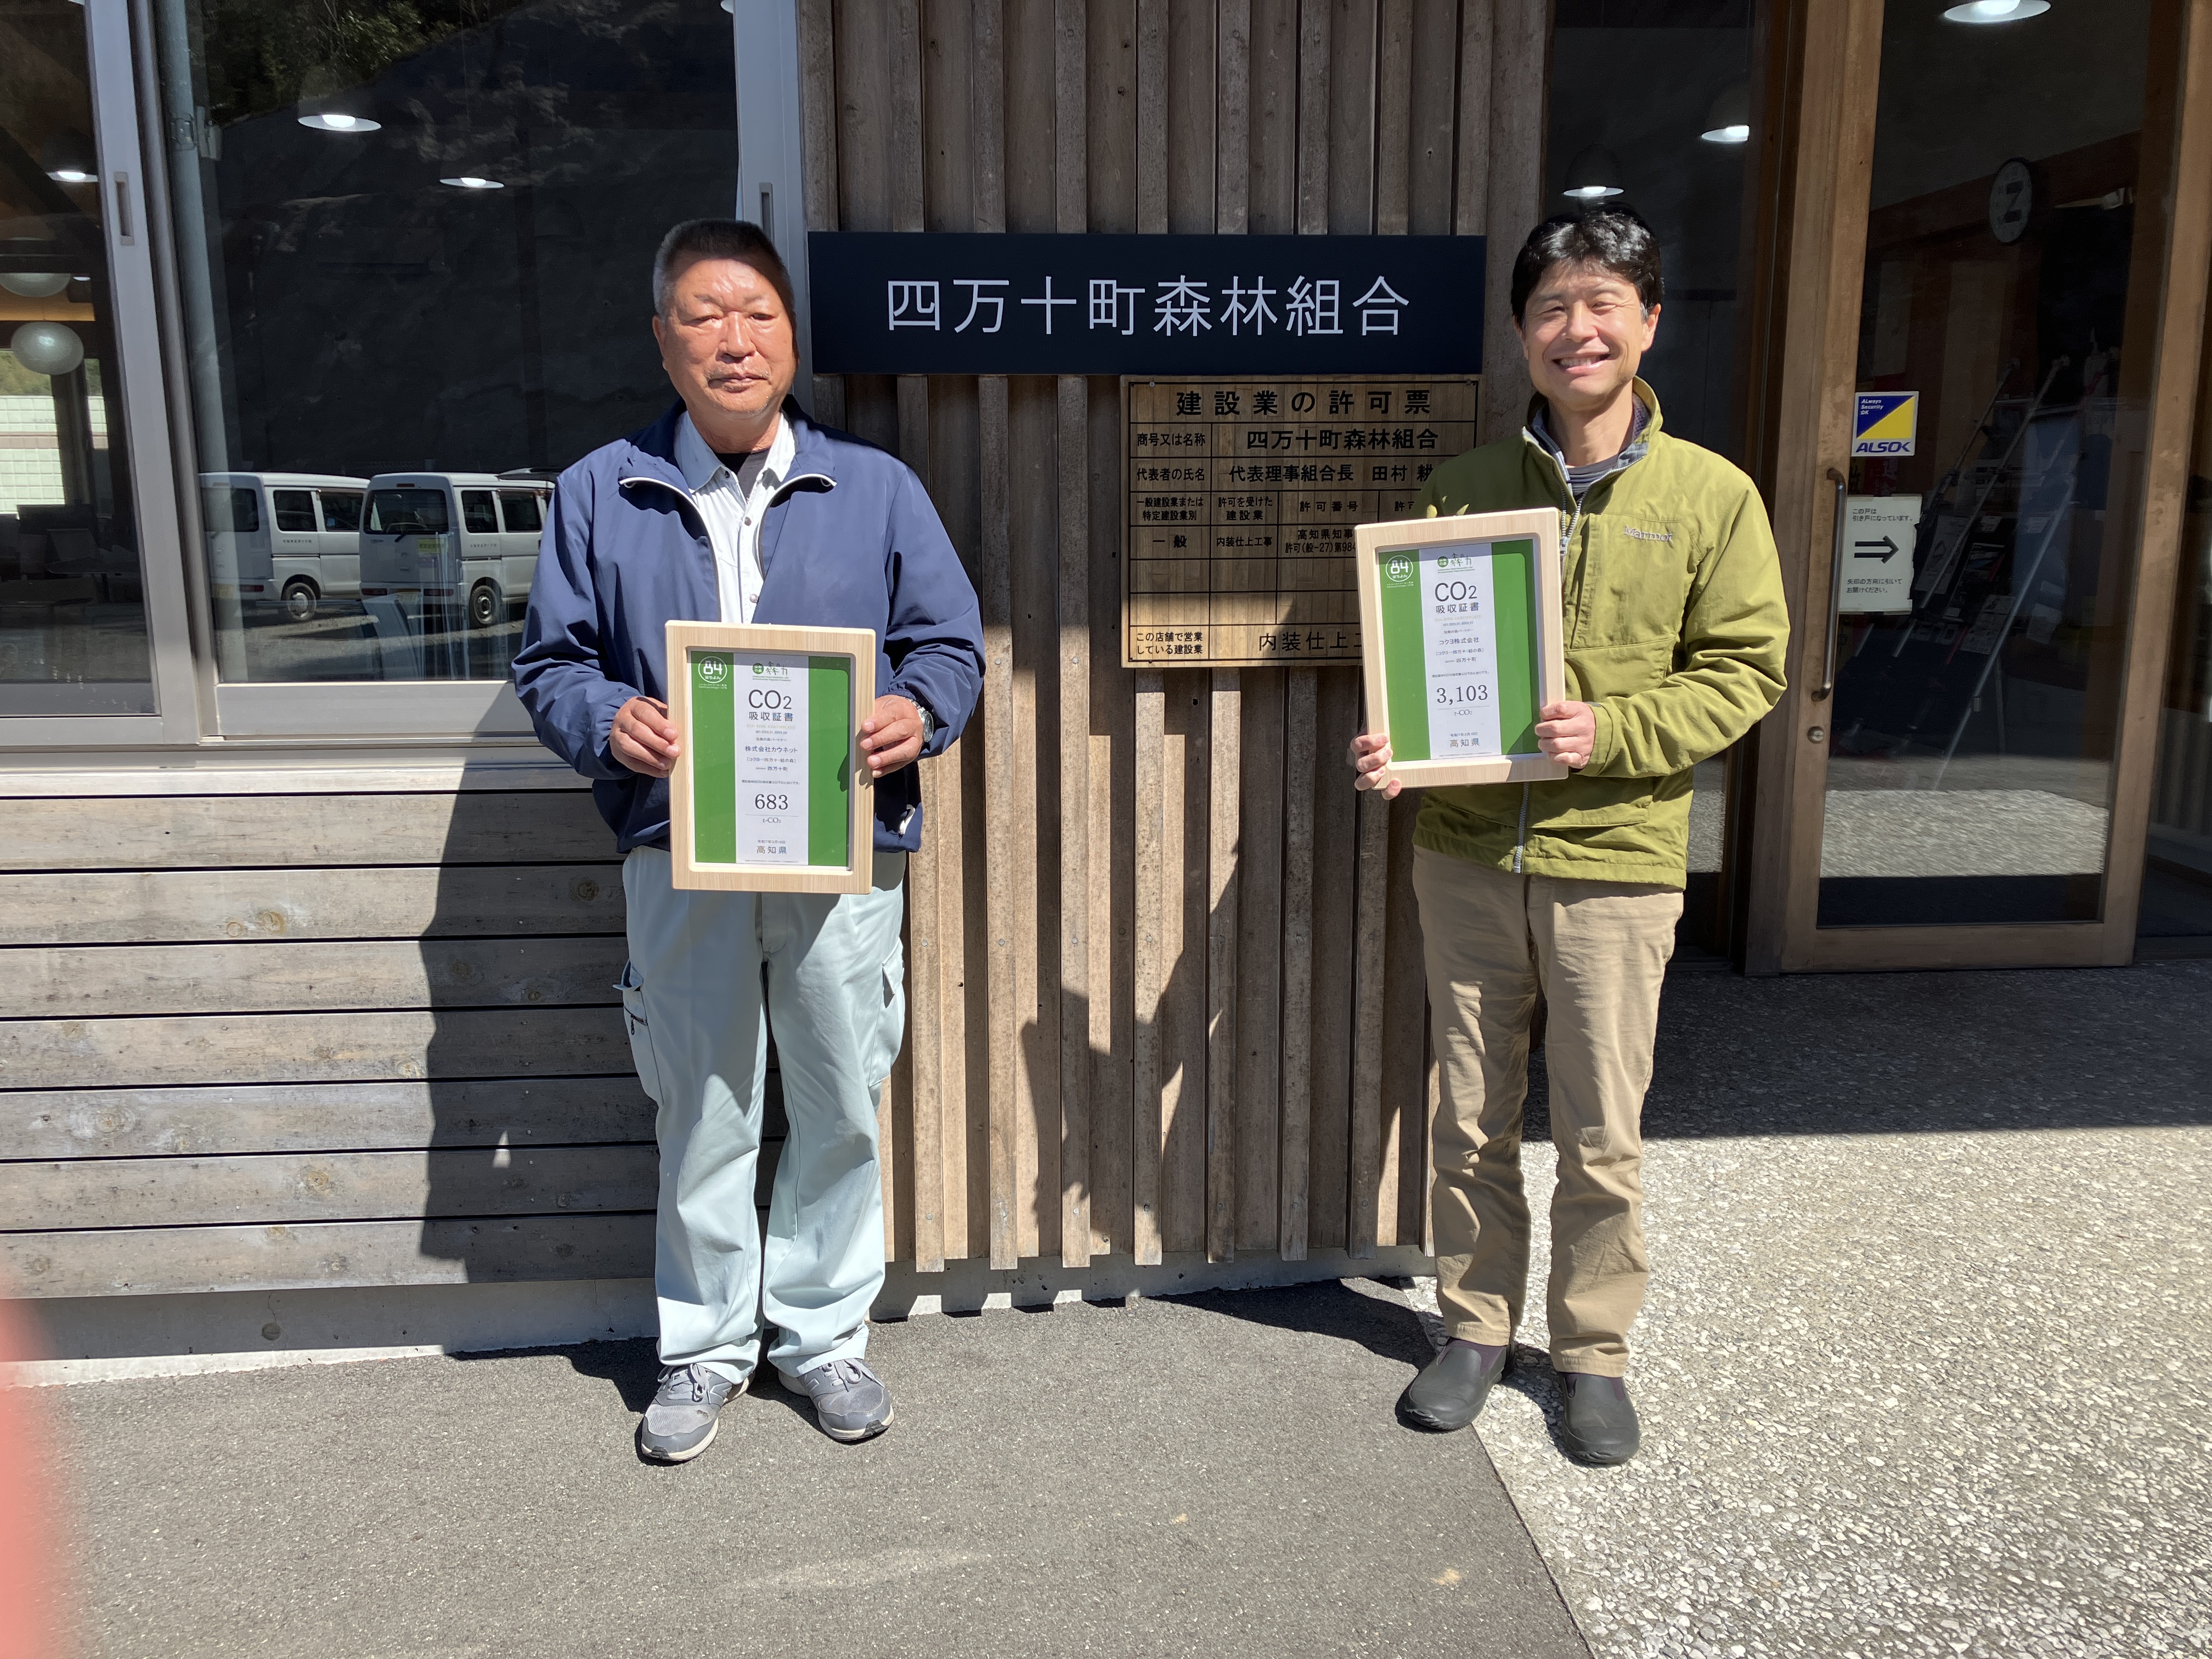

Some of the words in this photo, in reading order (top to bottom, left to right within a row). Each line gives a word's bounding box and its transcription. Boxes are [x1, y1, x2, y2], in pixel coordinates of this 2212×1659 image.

[886, 275, 1410, 336] 四万十町森林組合
[1176, 389, 1431, 416] 建設業の許可票
[1137, 432, 1206, 447] 商号又は名称
[1246, 429, 1439, 450] 四万十町森林組合
[1856, 441, 1911, 453] ALSOK
[1137, 467, 1205, 482] 代表者の氏名
[1228, 465, 1355, 482] 代表理事組合長
[1373, 465, 1408, 482] 田村
[1136, 496, 1204, 507] 一般建設業または
[1218, 496, 1273, 508] 許可を受けた
[1300, 500, 1359, 512] 許可番号
[1142, 510, 1197, 521] 特定建設業別
[1226, 510, 1263, 521] 建設業
[1297, 528, 1353, 540] 高知県知事
[1624, 525, 1673, 542] Marmot
[1153, 535, 1187, 548] 一般
[1216, 537, 1272, 547] 内装仕上工事
[1390, 560, 1409, 574] 84
[1436, 602, 1480, 614] 吸収証書
[1137, 632, 1203, 642] この店舗で営業
[1439, 636, 1480, 645] コクヨ株式会社
[1137, 644, 1203, 654] している建設業
[703, 660, 723, 675] 84
[1437, 685, 1488, 705] 3,103
[749, 712, 794, 721] 吸収証書
[1450, 738, 1480, 748] 高知県
[755, 794, 788, 810] 683
[757, 845, 787, 854] 高知県
